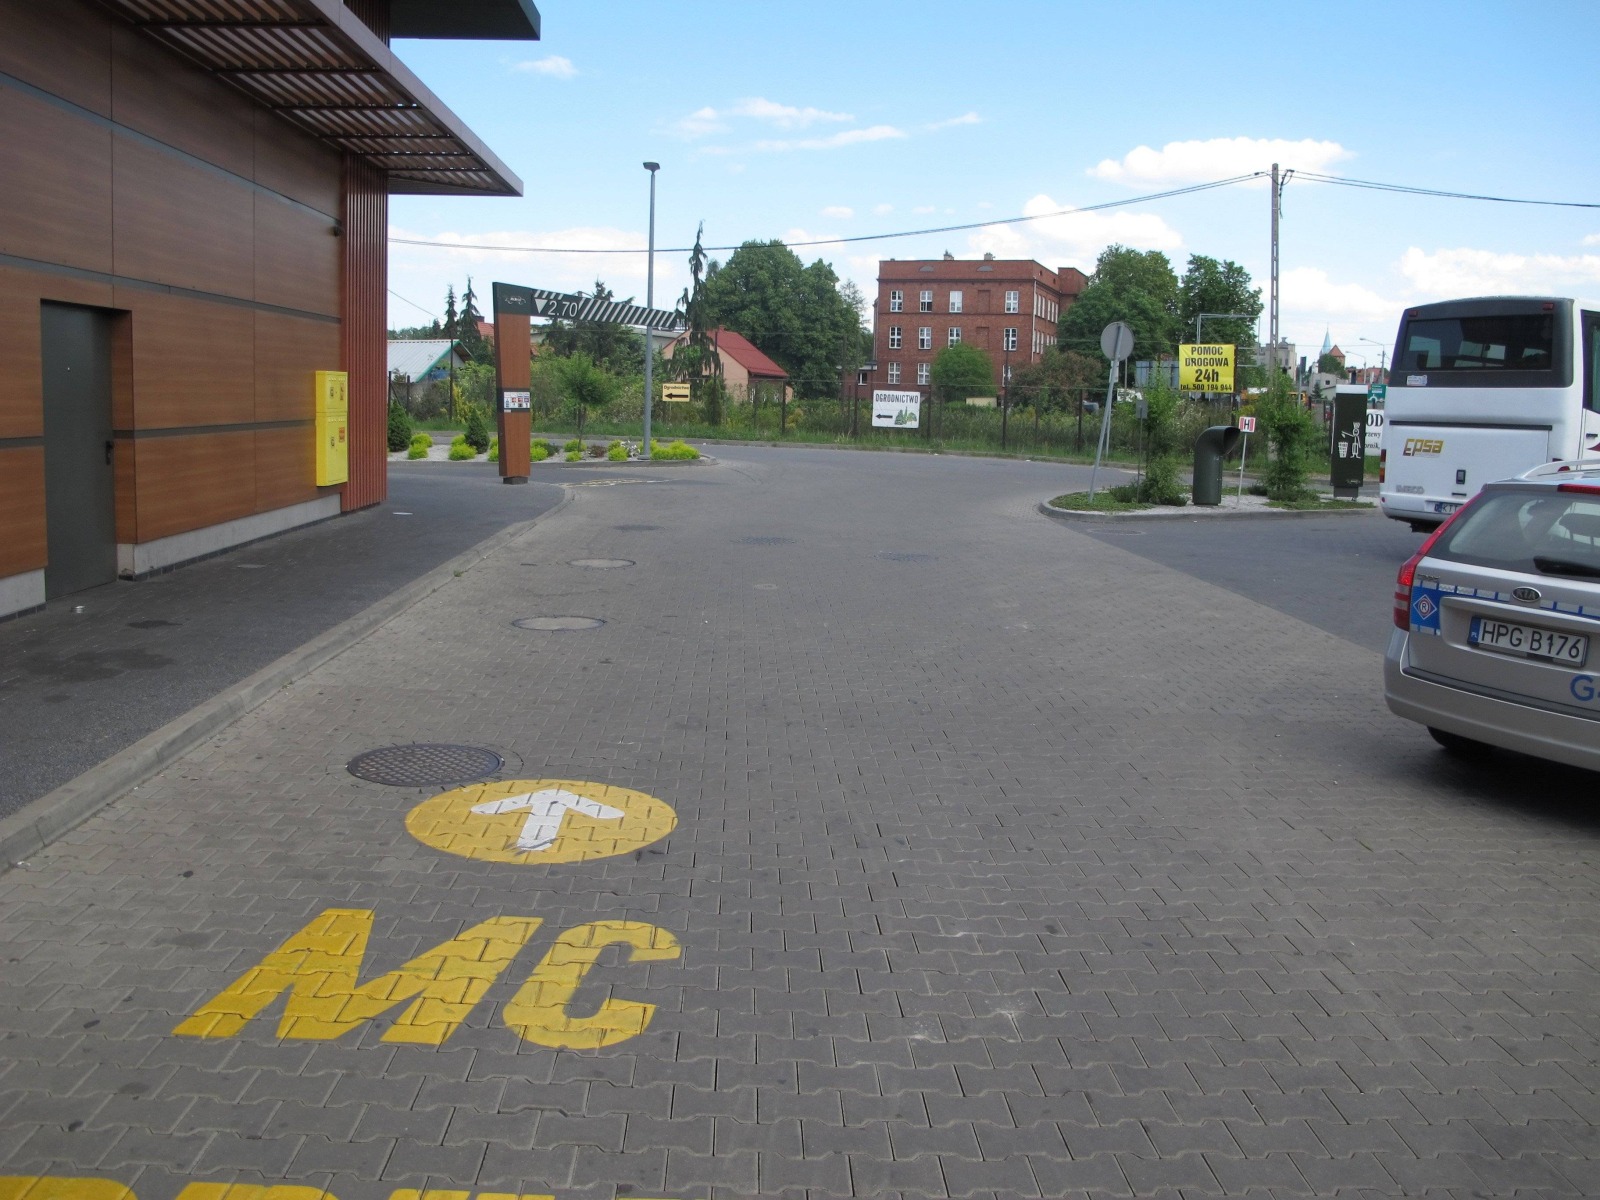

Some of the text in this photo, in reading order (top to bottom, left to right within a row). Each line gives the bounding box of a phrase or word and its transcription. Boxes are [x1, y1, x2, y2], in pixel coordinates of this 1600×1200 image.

[547, 300, 578, 317] 2.70
[1191, 346, 1223, 356] POMOC
[1185, 357, 1229, 367] DROGOWA
[1195, 368, 1219, 383] 24h
[1193, 383, 1205, 391] 500
[875, 393, 919, 404] OGRODNICTWO
[1243, 418, 1250, 430] H
[1481, 621, 1582, 659] HPG B176
[1569, 674, 1600, 702] G
[172, 908, 682, 1050] MC
